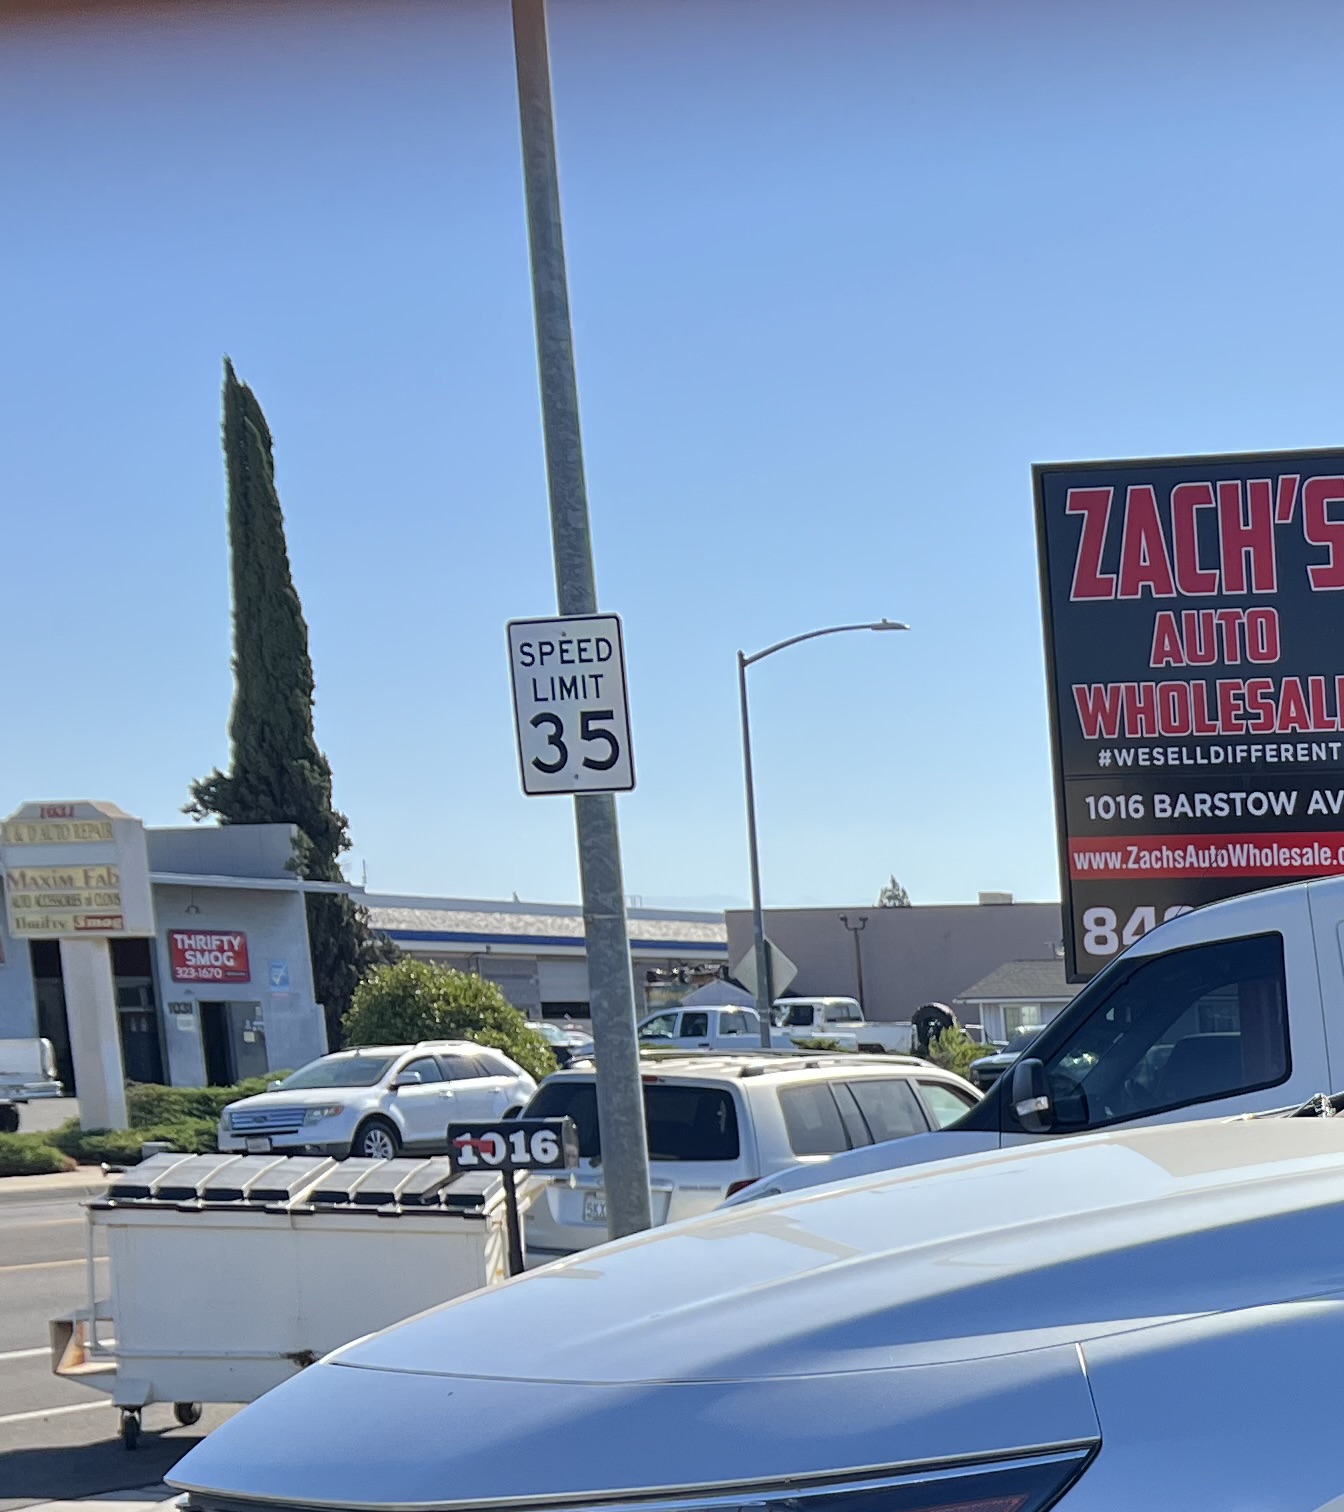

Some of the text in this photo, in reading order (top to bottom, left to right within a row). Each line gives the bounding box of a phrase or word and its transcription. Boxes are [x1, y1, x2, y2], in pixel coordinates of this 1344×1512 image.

[1148, 606, 1282, 668] AUTO
[519, 637, 613, 667] SPEED
[532, 674, 604, 702] LIMIT
[529, 709, 620, 774] 35
[1098, 741, 1342, 767] #WESELLDIFFERENT
[1085, 794, 1145, 821] 1016
[1154, 790, 1298, 818] BARSTOW
[74, 916, 123, 930] Smog
[173, 934, 241, 950] THRIFTY
[184, 951, 235, 966] SMOG
[175, 967, 223, 979] 323-1670
[455, 1129, 560, 1166] 1016
